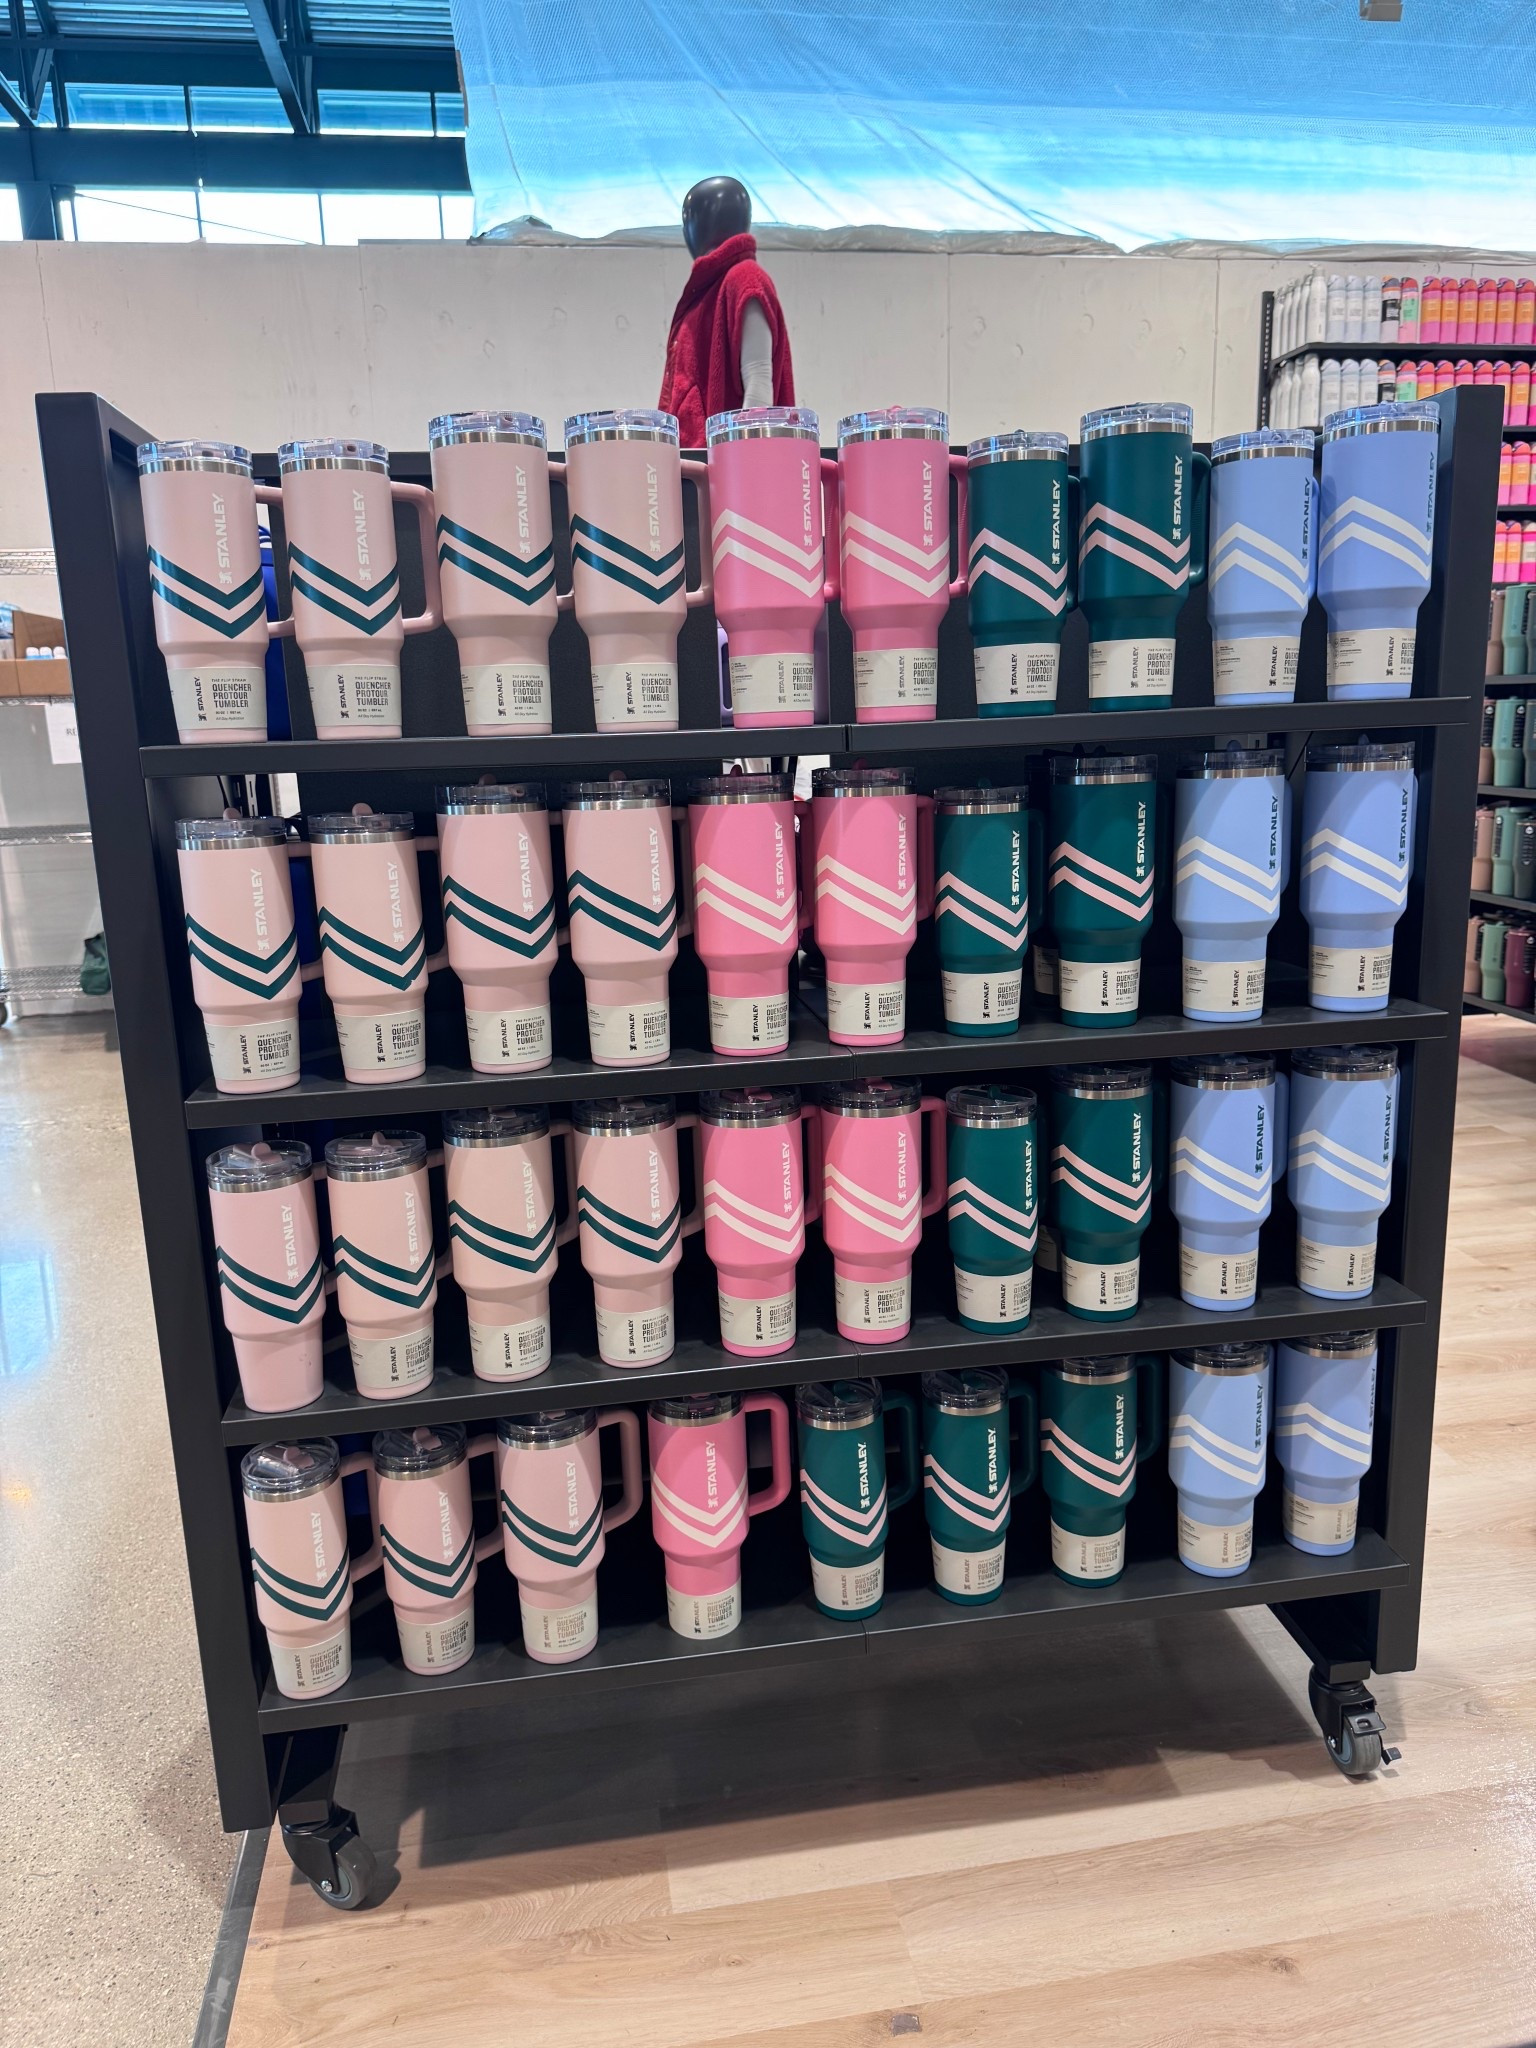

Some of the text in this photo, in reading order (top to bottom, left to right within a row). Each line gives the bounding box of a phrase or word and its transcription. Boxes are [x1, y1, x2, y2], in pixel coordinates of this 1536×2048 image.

[516, 466, 529, 538] STANLEY
[647, 464, 659, 536] STANLEY
[802, 460, 811, 531] STANLEY
[923, 461, 932, 531] STANLEY
[1174, 456, 1182, 524] STANLEY
[1303, 477, 1311, 545] STANLEY
[212, 494, 231, 567] STANLEY
[353, 490, 370, 564] STANLEY
[194, 677, 204, 710] STANLEY
[212, 684, 251, 692] QUENCHER
[214, 700, 248, 708] TUMBLER
[338, 675, 347, 708] STANLEY
[356, 682, 391, 690] QUENCHER
[357, 698, 388, 706] TUMBLER
[513, 680, 543, 688] QUENCHER
[775, 822, 783, 885] STANLEY
[1270, 796, 1278, 856] STANLEY
[518, 833, 532, 898] STANLEY
[649, 828, 660, 892] STANLEY
[1012, 831, 1020, 893] STANLEY
[251, 869, 267, 935] STANLEY
[388, 862, 402, 928] STANLEY
[240, 1035, 248, 1064] STANLEY
[258, 1034, 291, 1046] QUENCHER
[258, 1043, 288, 1053] PROTOUR
[259, 1050, 289, 1061] TUMBLER
[392, 1023, 421, 1035] QUENCHER
[393, 1031, 418, 1042] PROTOUR
[393, 1038, 419, 1049] TUMBLER
[1133, 1113, 1141, 1169] STANLEY
[1256, 1105, 1264, 1160] STANLEY
[523, 1162, 535, 1218] STANLEY
[649, 1150, 660, 1209] STANLEY
[782, 1143, 792, 1200] STANLEY
[281, 1205, 296, 1266] STANLEY
[405, 1192, 418, 1250] STANLEY
[390, 1347, 398, 1373] STANLEY
[706, 1442, 717, 1495] STANLEY
[858, 1442, 869, 1496] STANLEY
[989, 1428, 997, 1481] STANLEY
[567, 1462, 578, 1516] STANLEY
[311, 1512, 326, 1567] STANLEY
[439, 1492, 452, 1545] STANLEY
